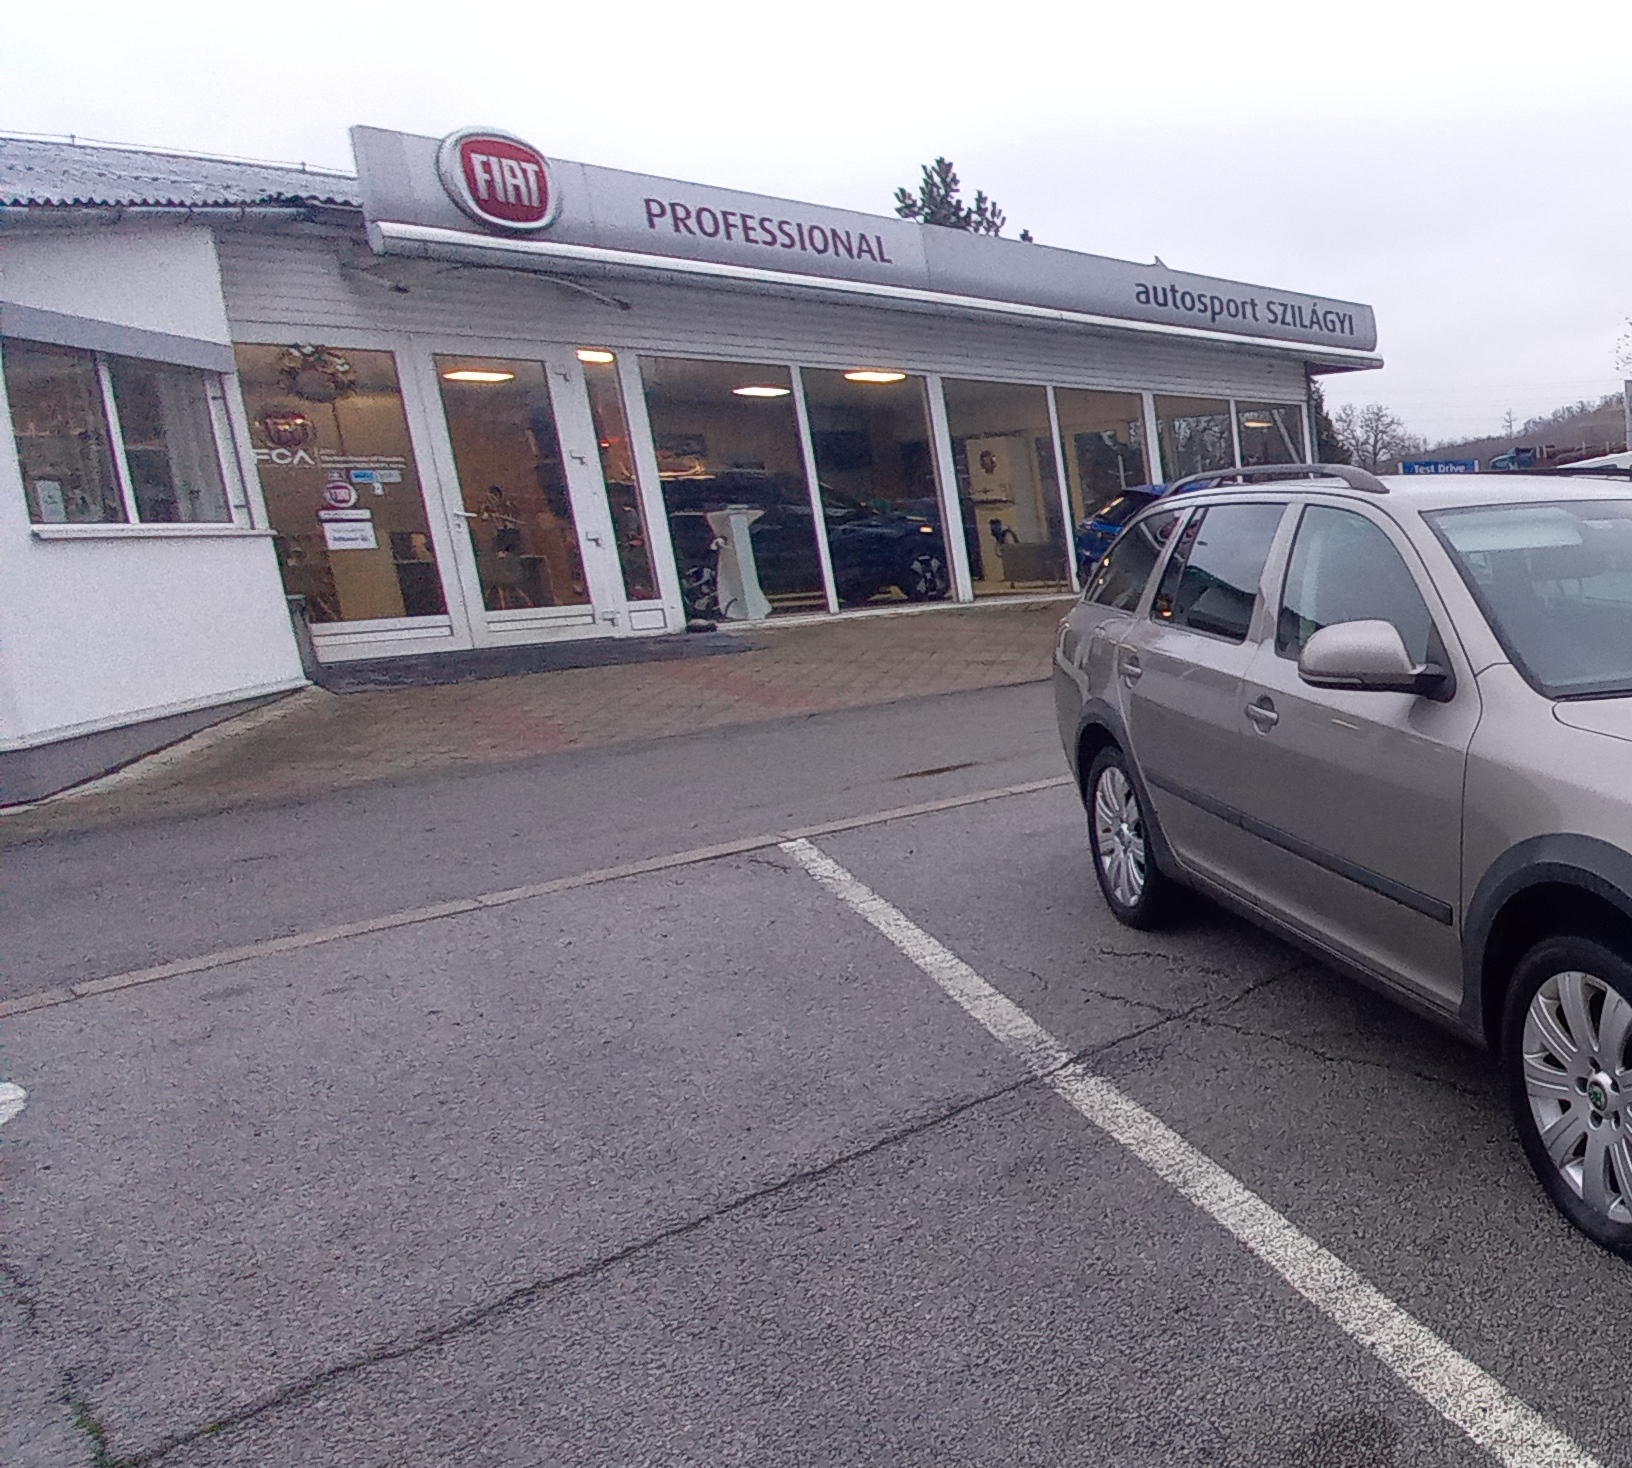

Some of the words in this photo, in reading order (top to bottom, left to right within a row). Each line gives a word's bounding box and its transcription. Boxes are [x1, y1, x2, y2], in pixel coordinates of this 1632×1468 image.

[470, 152, 542, 208] FIAT
[643, 198, 893, 264] PROFESSIONAL
[1134, 283, 1260, 323] autosport
[1267, 301, 1355, 336] SZILÁGYI
[1413, 464, 1435, 473] Test
[1438, 463, 1466, 473] Drive
